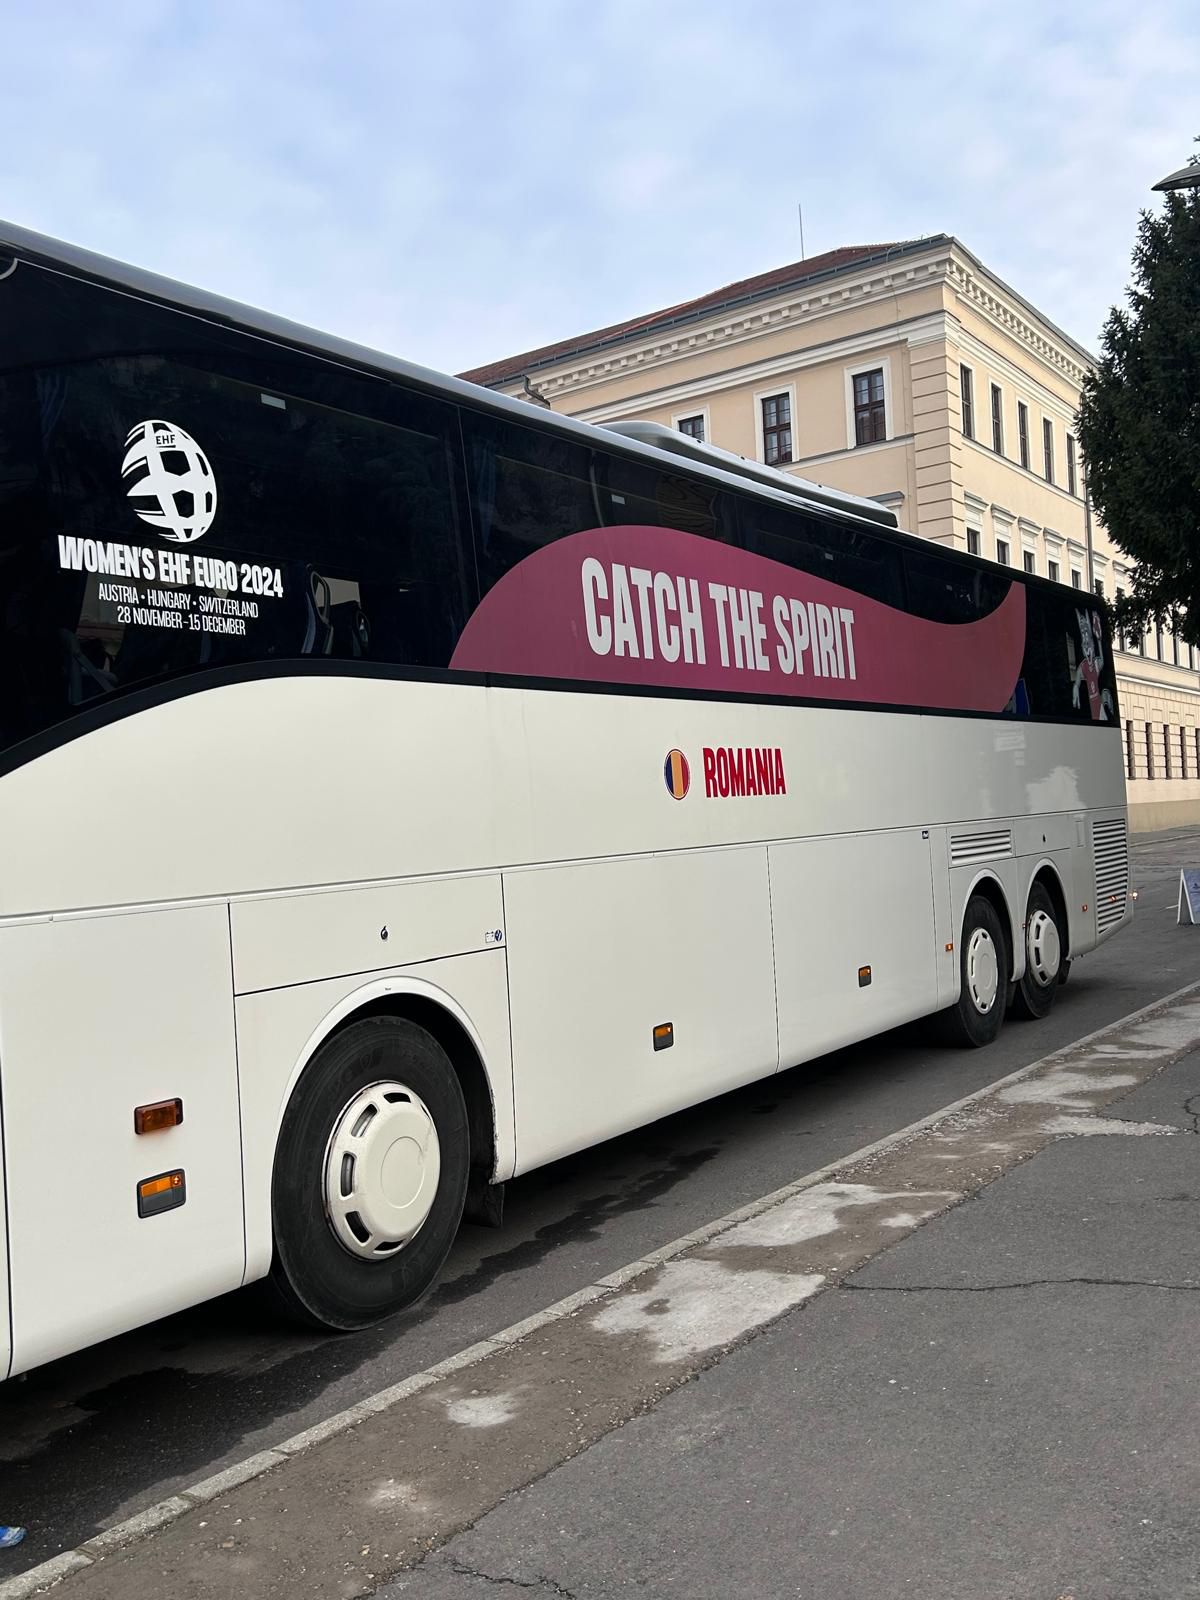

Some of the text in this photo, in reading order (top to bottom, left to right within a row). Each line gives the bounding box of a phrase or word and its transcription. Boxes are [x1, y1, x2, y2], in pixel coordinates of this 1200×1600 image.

[155, 434, 176, 445] EHF
[58, 534, 284, 598] WOMEN'S EHF EURO 2024
[98, 582, 259, 619] AUSTRIA HUNGARY SWITZERLAND
[117, 605, 131, 624] 28
[202, 614, 246, 636] DECEMBER
[581, 557, 857, 681] CATCH THE SPIRIT
[702, 746, 787, 799] ROMANIA
